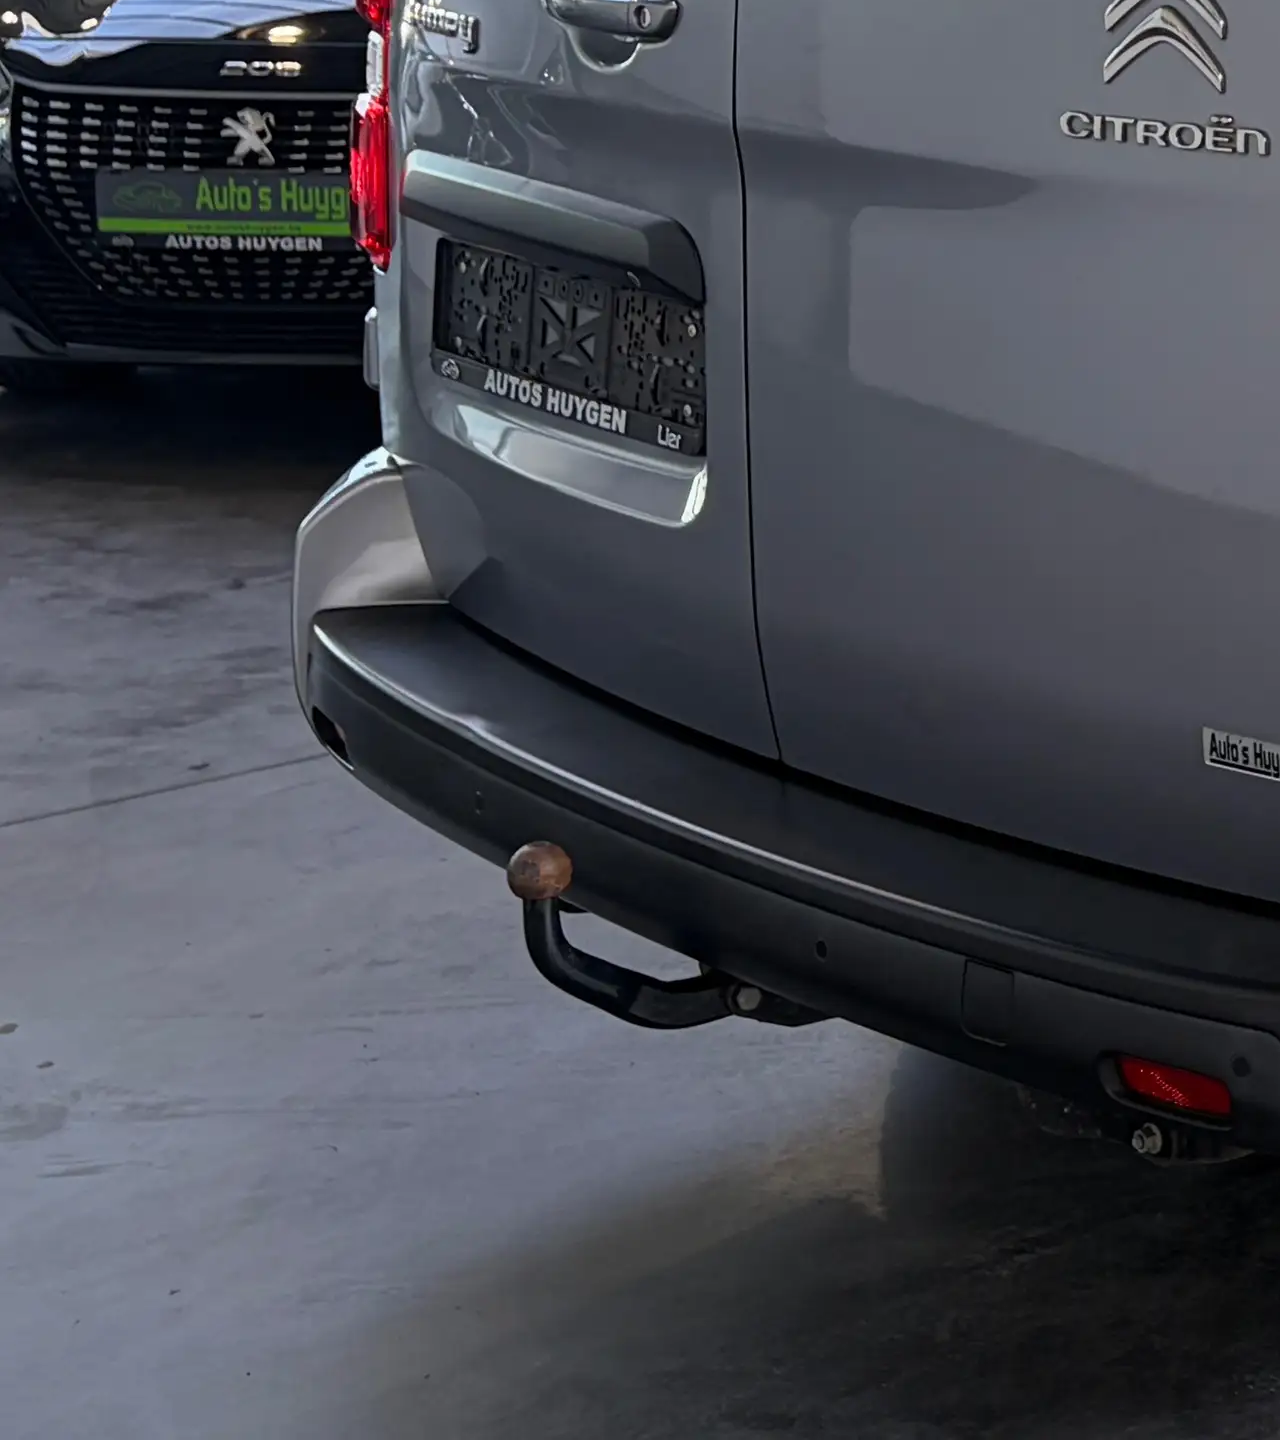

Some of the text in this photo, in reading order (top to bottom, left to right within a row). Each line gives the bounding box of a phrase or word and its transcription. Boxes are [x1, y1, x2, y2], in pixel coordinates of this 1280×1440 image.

[219, 60, 302, 77] 208
[1059, 110, 1271, 157] CITROËN
[195, 176, 272, 213] Auto's
[164, 234, 323, 252] AUTOS HUYGEN
[483, 368, 627, 434] AUTOS HUYGEN
[657, 424, 682, 450] Lier
[1208, 731, 1250, 765] Auto's
